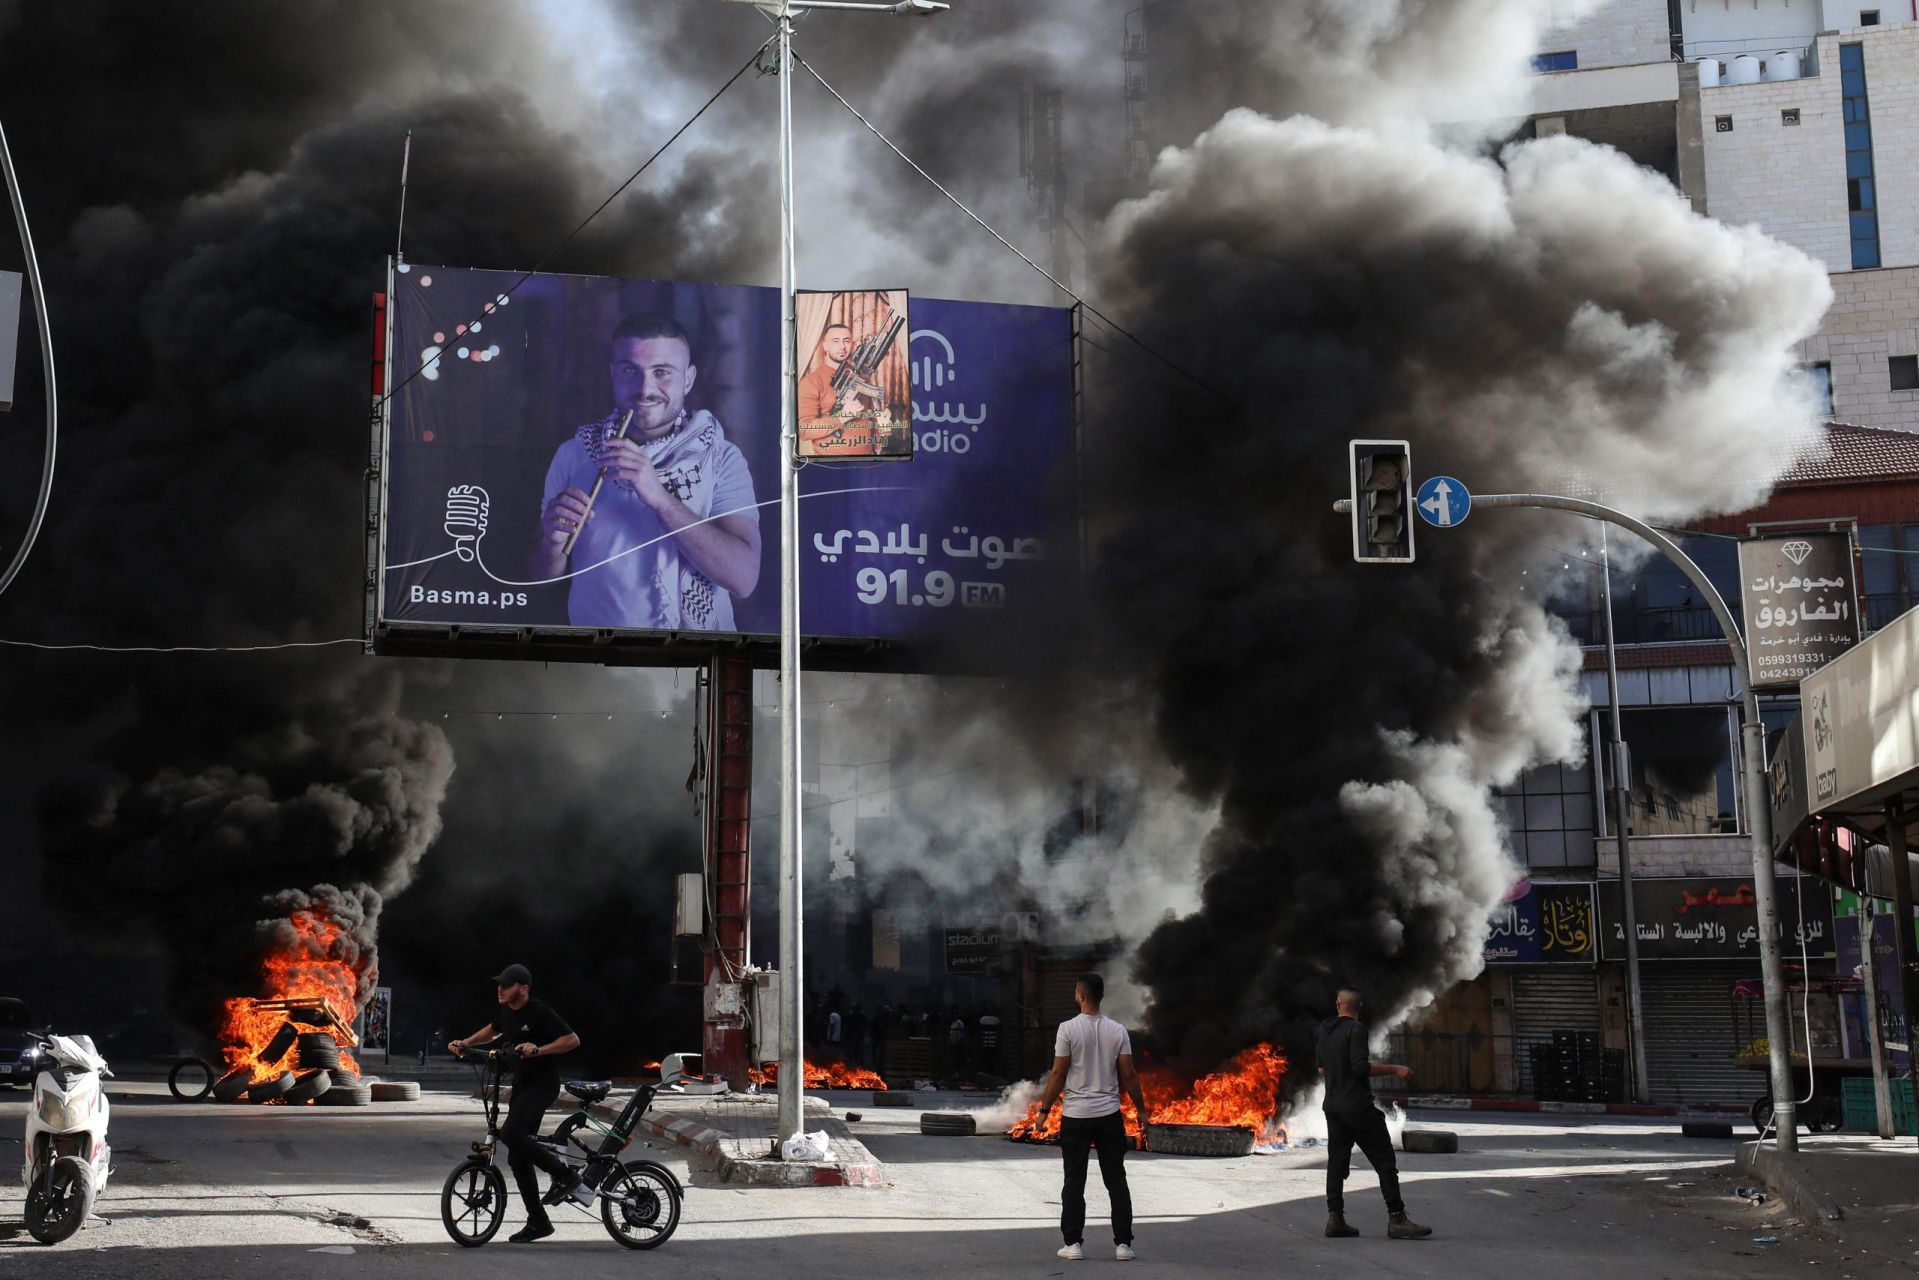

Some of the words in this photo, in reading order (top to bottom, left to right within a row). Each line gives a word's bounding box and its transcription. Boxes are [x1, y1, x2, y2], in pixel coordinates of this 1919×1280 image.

[913, 429, 971, 454] dio
[813, 523, 928, 565] بلادي
[941, 526, 1043, 570] صوت
[410, 585, 528, 609] Basma.ps
[856, 567, 955, 608] 91.9
[965, 584, 1000, 606] FM
[1751, 575, 1845, 594] مجوهرات
[1755, 597, 1848, 629] الفاروق
[1758, 653, 1825, 666] 0599319331
[1817, 770, 1836, 797] baby
